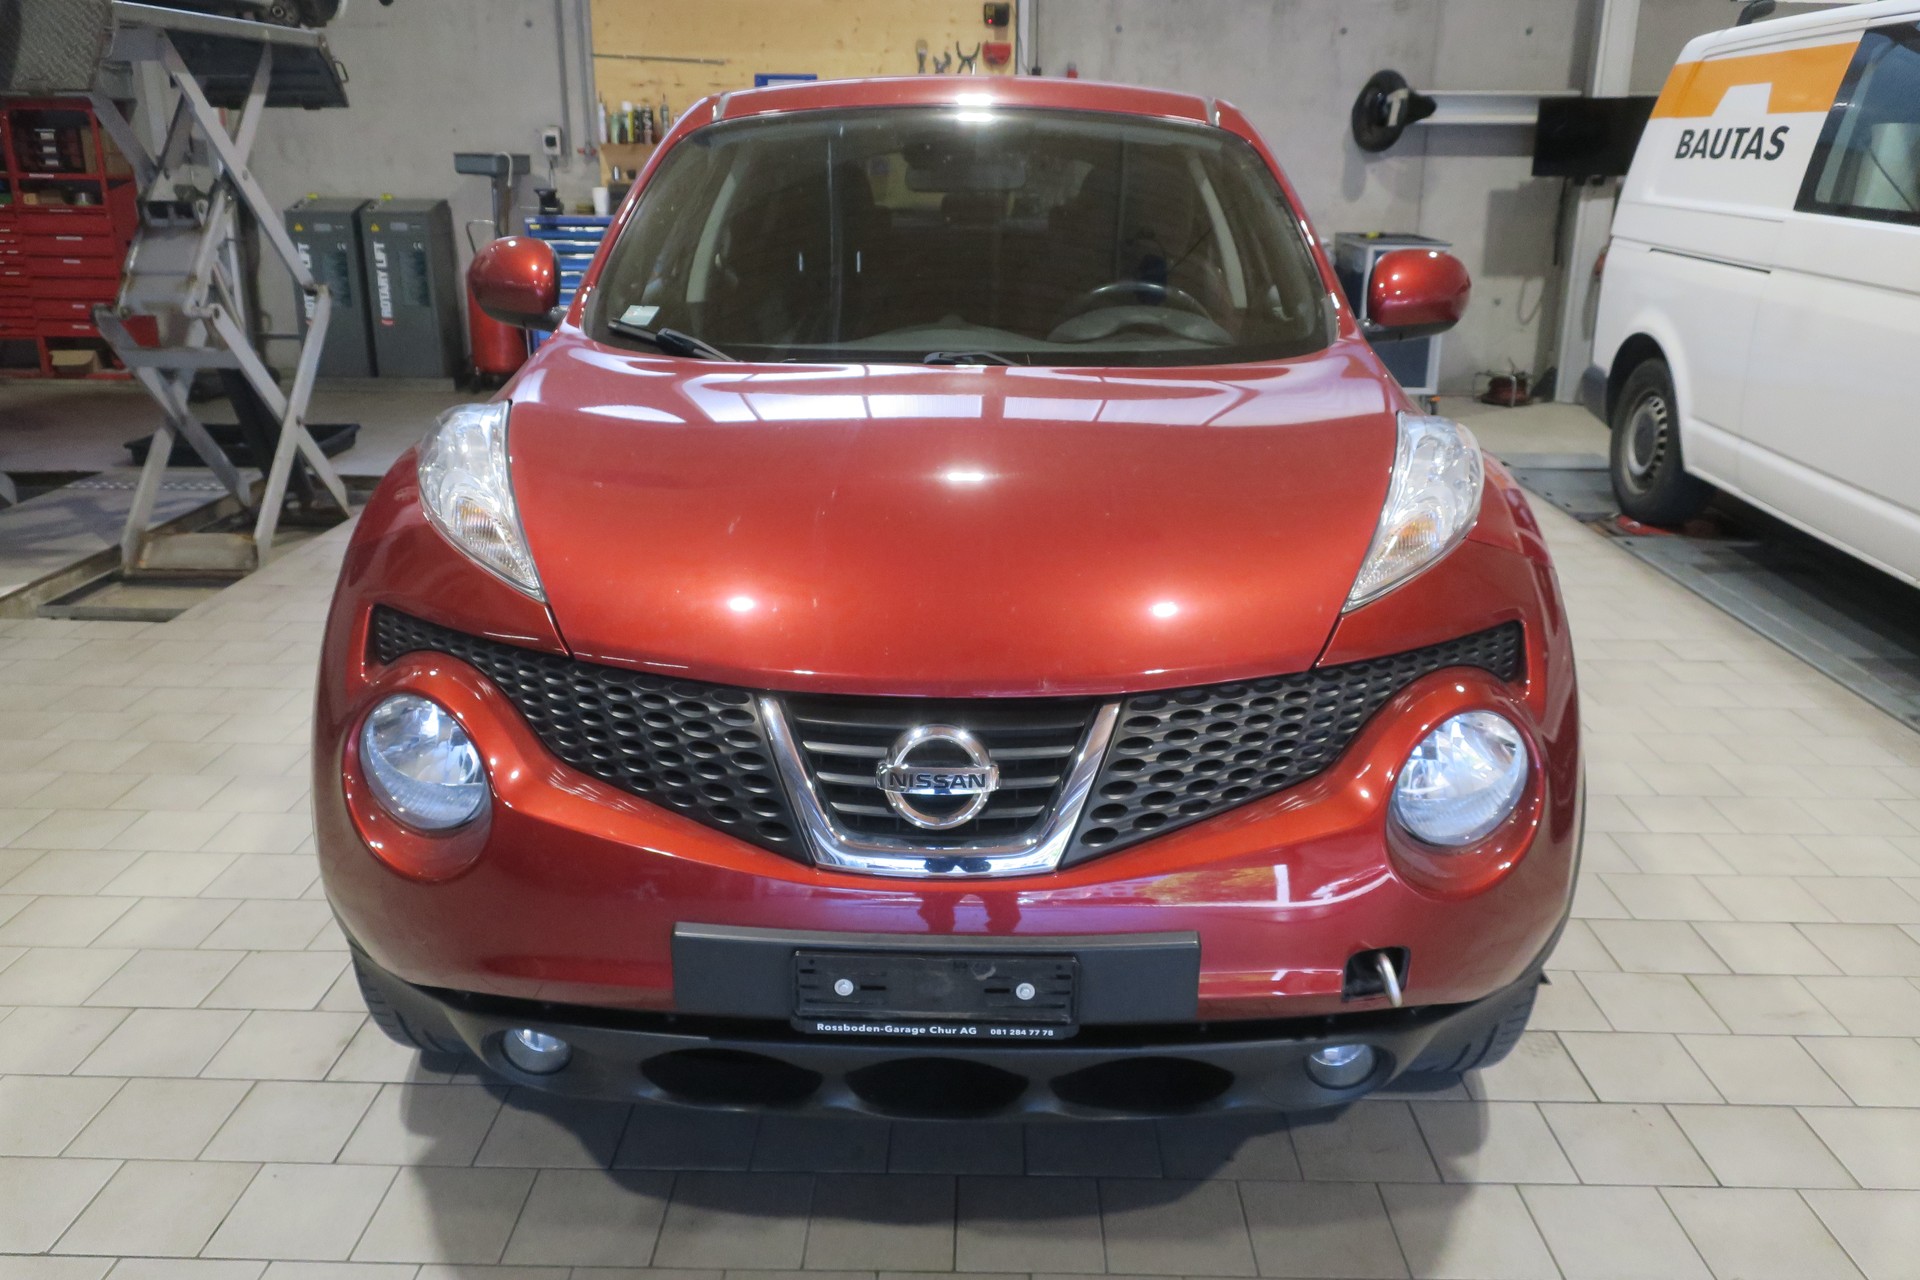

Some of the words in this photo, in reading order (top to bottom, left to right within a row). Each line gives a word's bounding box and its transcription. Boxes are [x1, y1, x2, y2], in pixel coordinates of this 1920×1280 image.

[1675, 125, 1790, 161] BAUTAS
[373, 241, 388, 268] LIFT
[376, 269, 393, 318] ROTARY
[889, 772, 986, 789] NISSAN
[816, 1023, 926, 1036] Rossboden-Garage
[929, 1026, 957, 1035] Chur
[959, 1027, 978, 1035] AG
[990, 1028, 1007, 1036] 081
[1028, 1029, 1041, 1037] 77
[1042, 1029, 1055, 1037] 78
